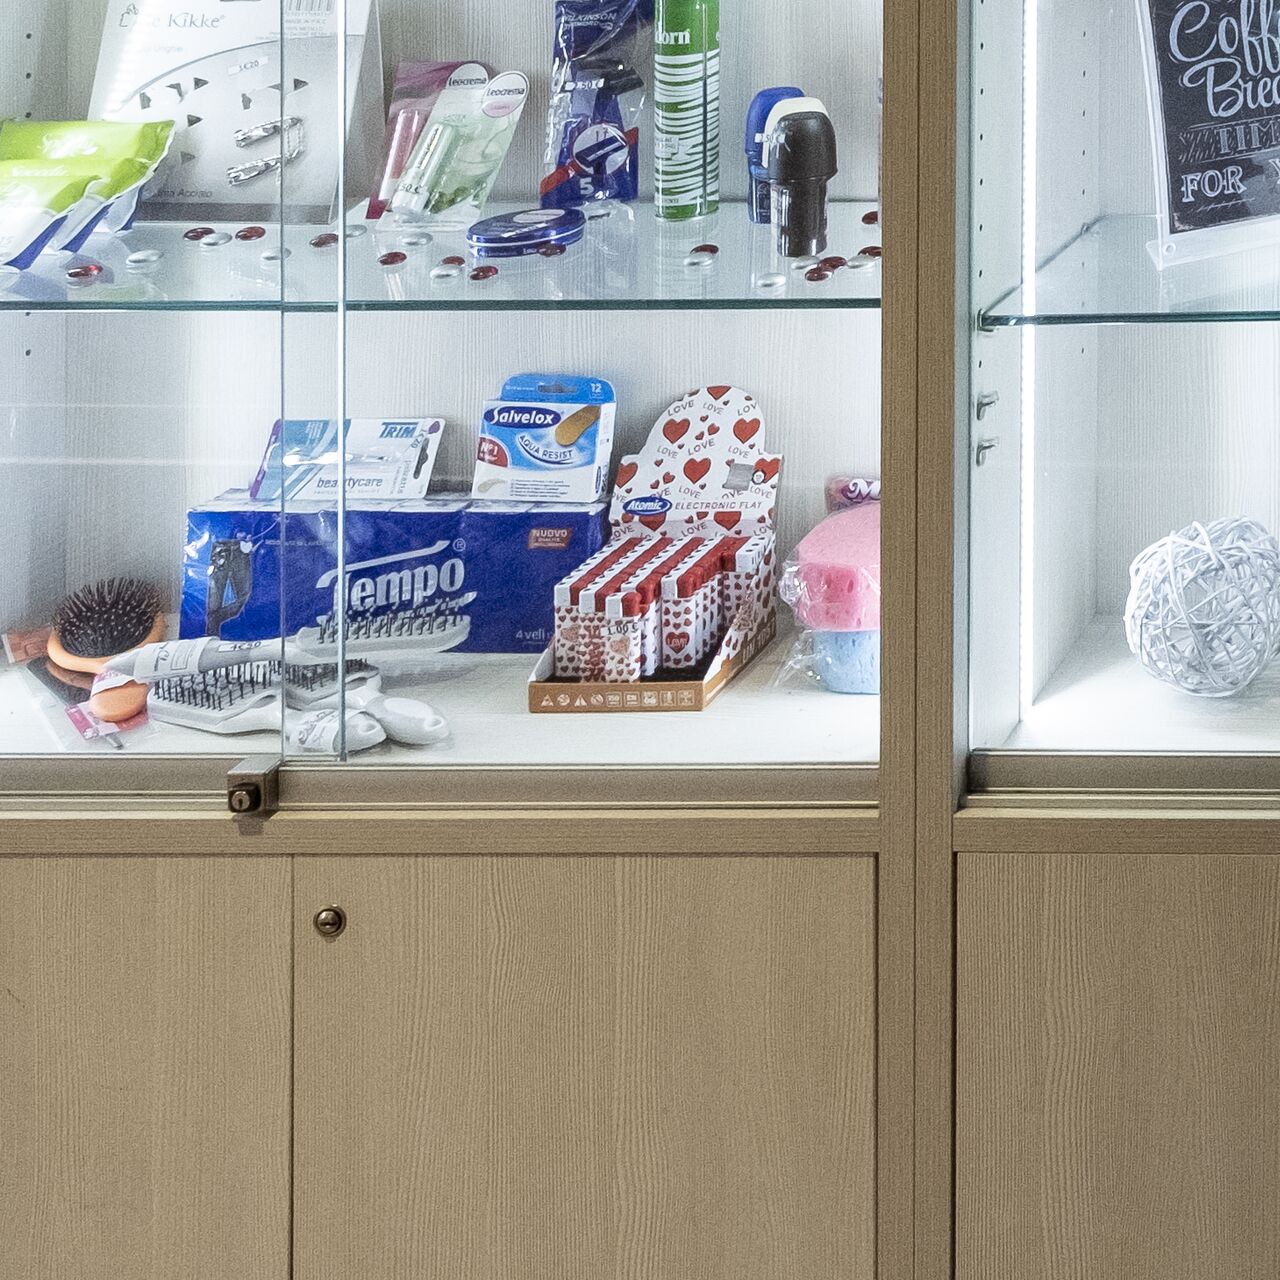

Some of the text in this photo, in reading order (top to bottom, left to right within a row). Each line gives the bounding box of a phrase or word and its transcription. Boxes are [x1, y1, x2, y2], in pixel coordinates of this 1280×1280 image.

[1181, 165, 1247, 203] FOR
[590, 383, 602, 393] 12
[667, 399, 695, 417] LOVE
[702, 401, 725, 416] LOVE
[492, 407, 554, 425] Salvelox
[379, 422, 419, 439] TRIM
[519, 434, 574, 460] AQUA RESIST
[656, 445, 679, 460] LOVE
[687, 439, 715, 456] LOVE
[728, 445, 749, 460] LOVE
[678, 485, 702, 499] LOVE
[750, 485, 772, 499] LOVE
[626, 499, 664, 512] Atomic
[674, 501, 763, 510] ELECTRONIC FLAT
[532, 528, 568, 538] NUOVO
[681, 521, 708, 538] LOVE
[315, 540, 467, 615] Tempo
[515, 629, 524, 640] 4
